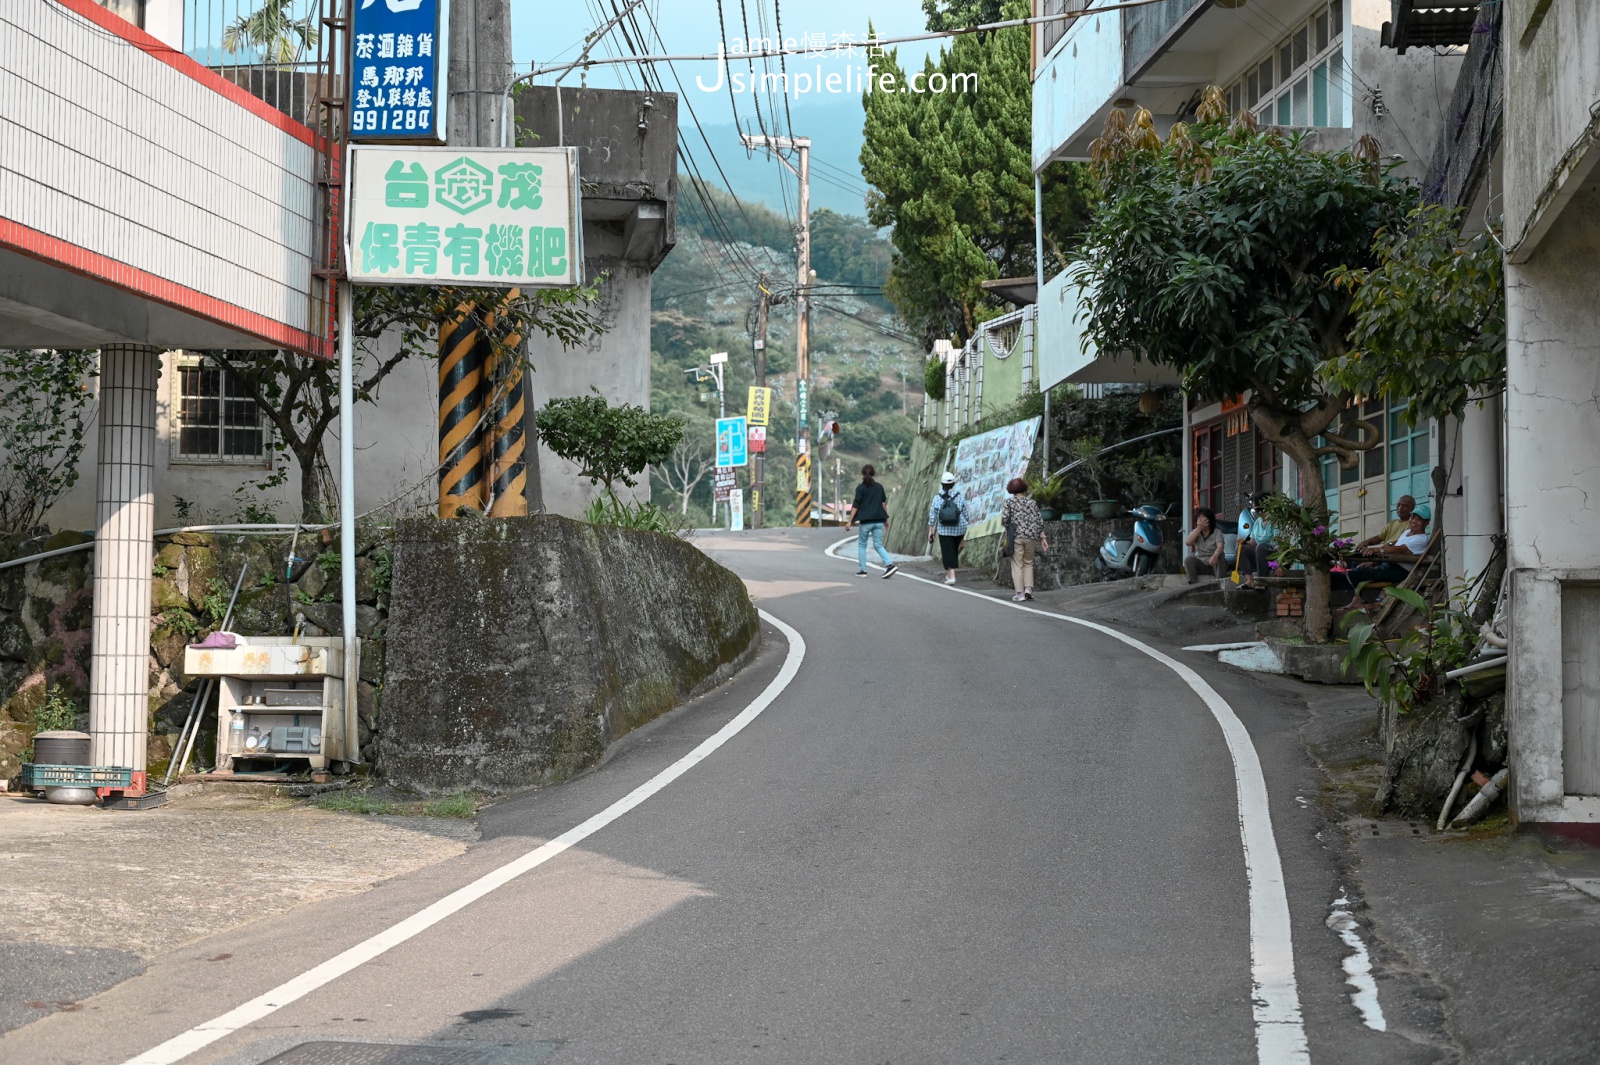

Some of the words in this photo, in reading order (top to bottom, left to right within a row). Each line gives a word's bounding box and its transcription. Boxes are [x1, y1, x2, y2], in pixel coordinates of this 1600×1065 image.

[356, 33, 433, 59] 菸酒雜貨
[360, 65, 424, 88] 馬那邦
[353, 109, 430, 130] 991284
[360, 221, 568, 277] 保青有機肥
